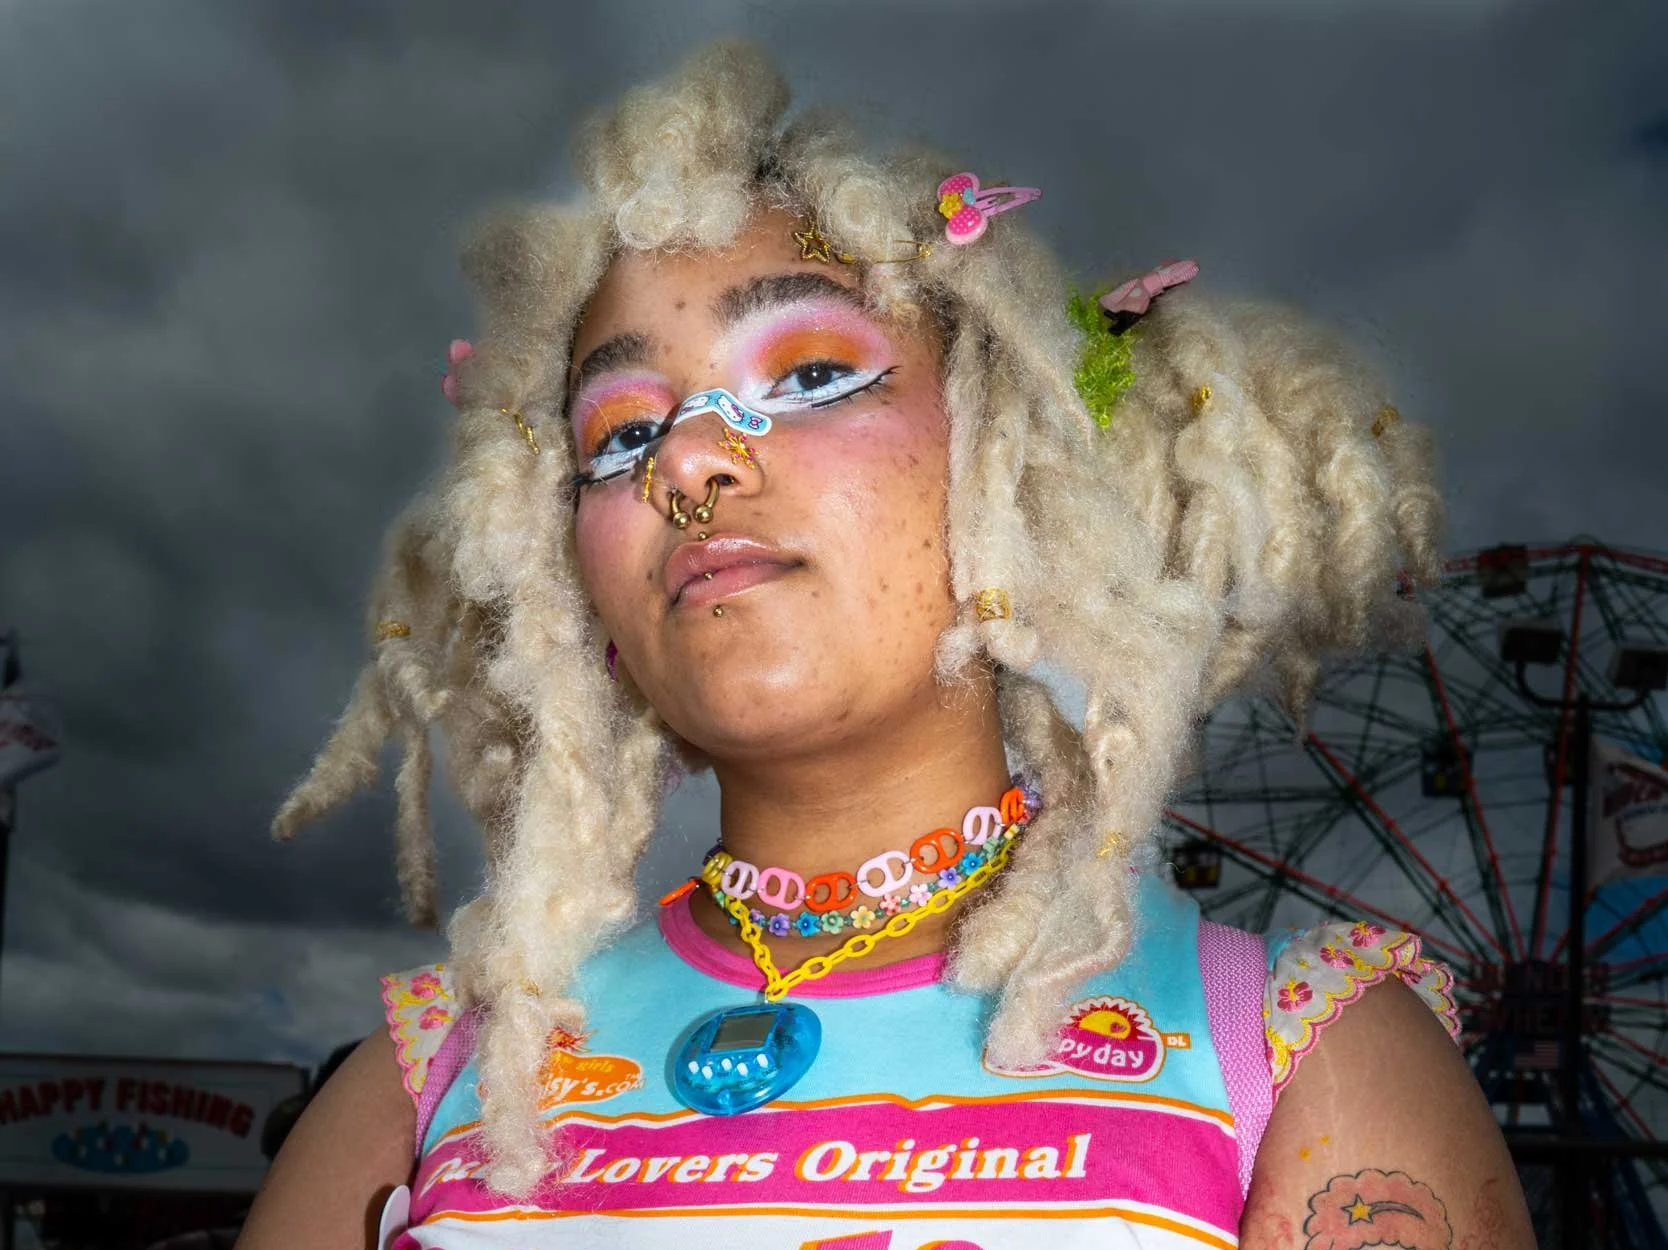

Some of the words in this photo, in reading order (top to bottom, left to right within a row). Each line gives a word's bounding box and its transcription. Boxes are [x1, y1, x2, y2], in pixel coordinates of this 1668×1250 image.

[1093, 1043, 1144, 1068] day
[0, 1078, 105, 1126] HAPPY
[116, 1077, 255, 1139] FISHING
[560, 1147, 779, 1184] Lovers
[795, 1132, 1092, 1194] Original
